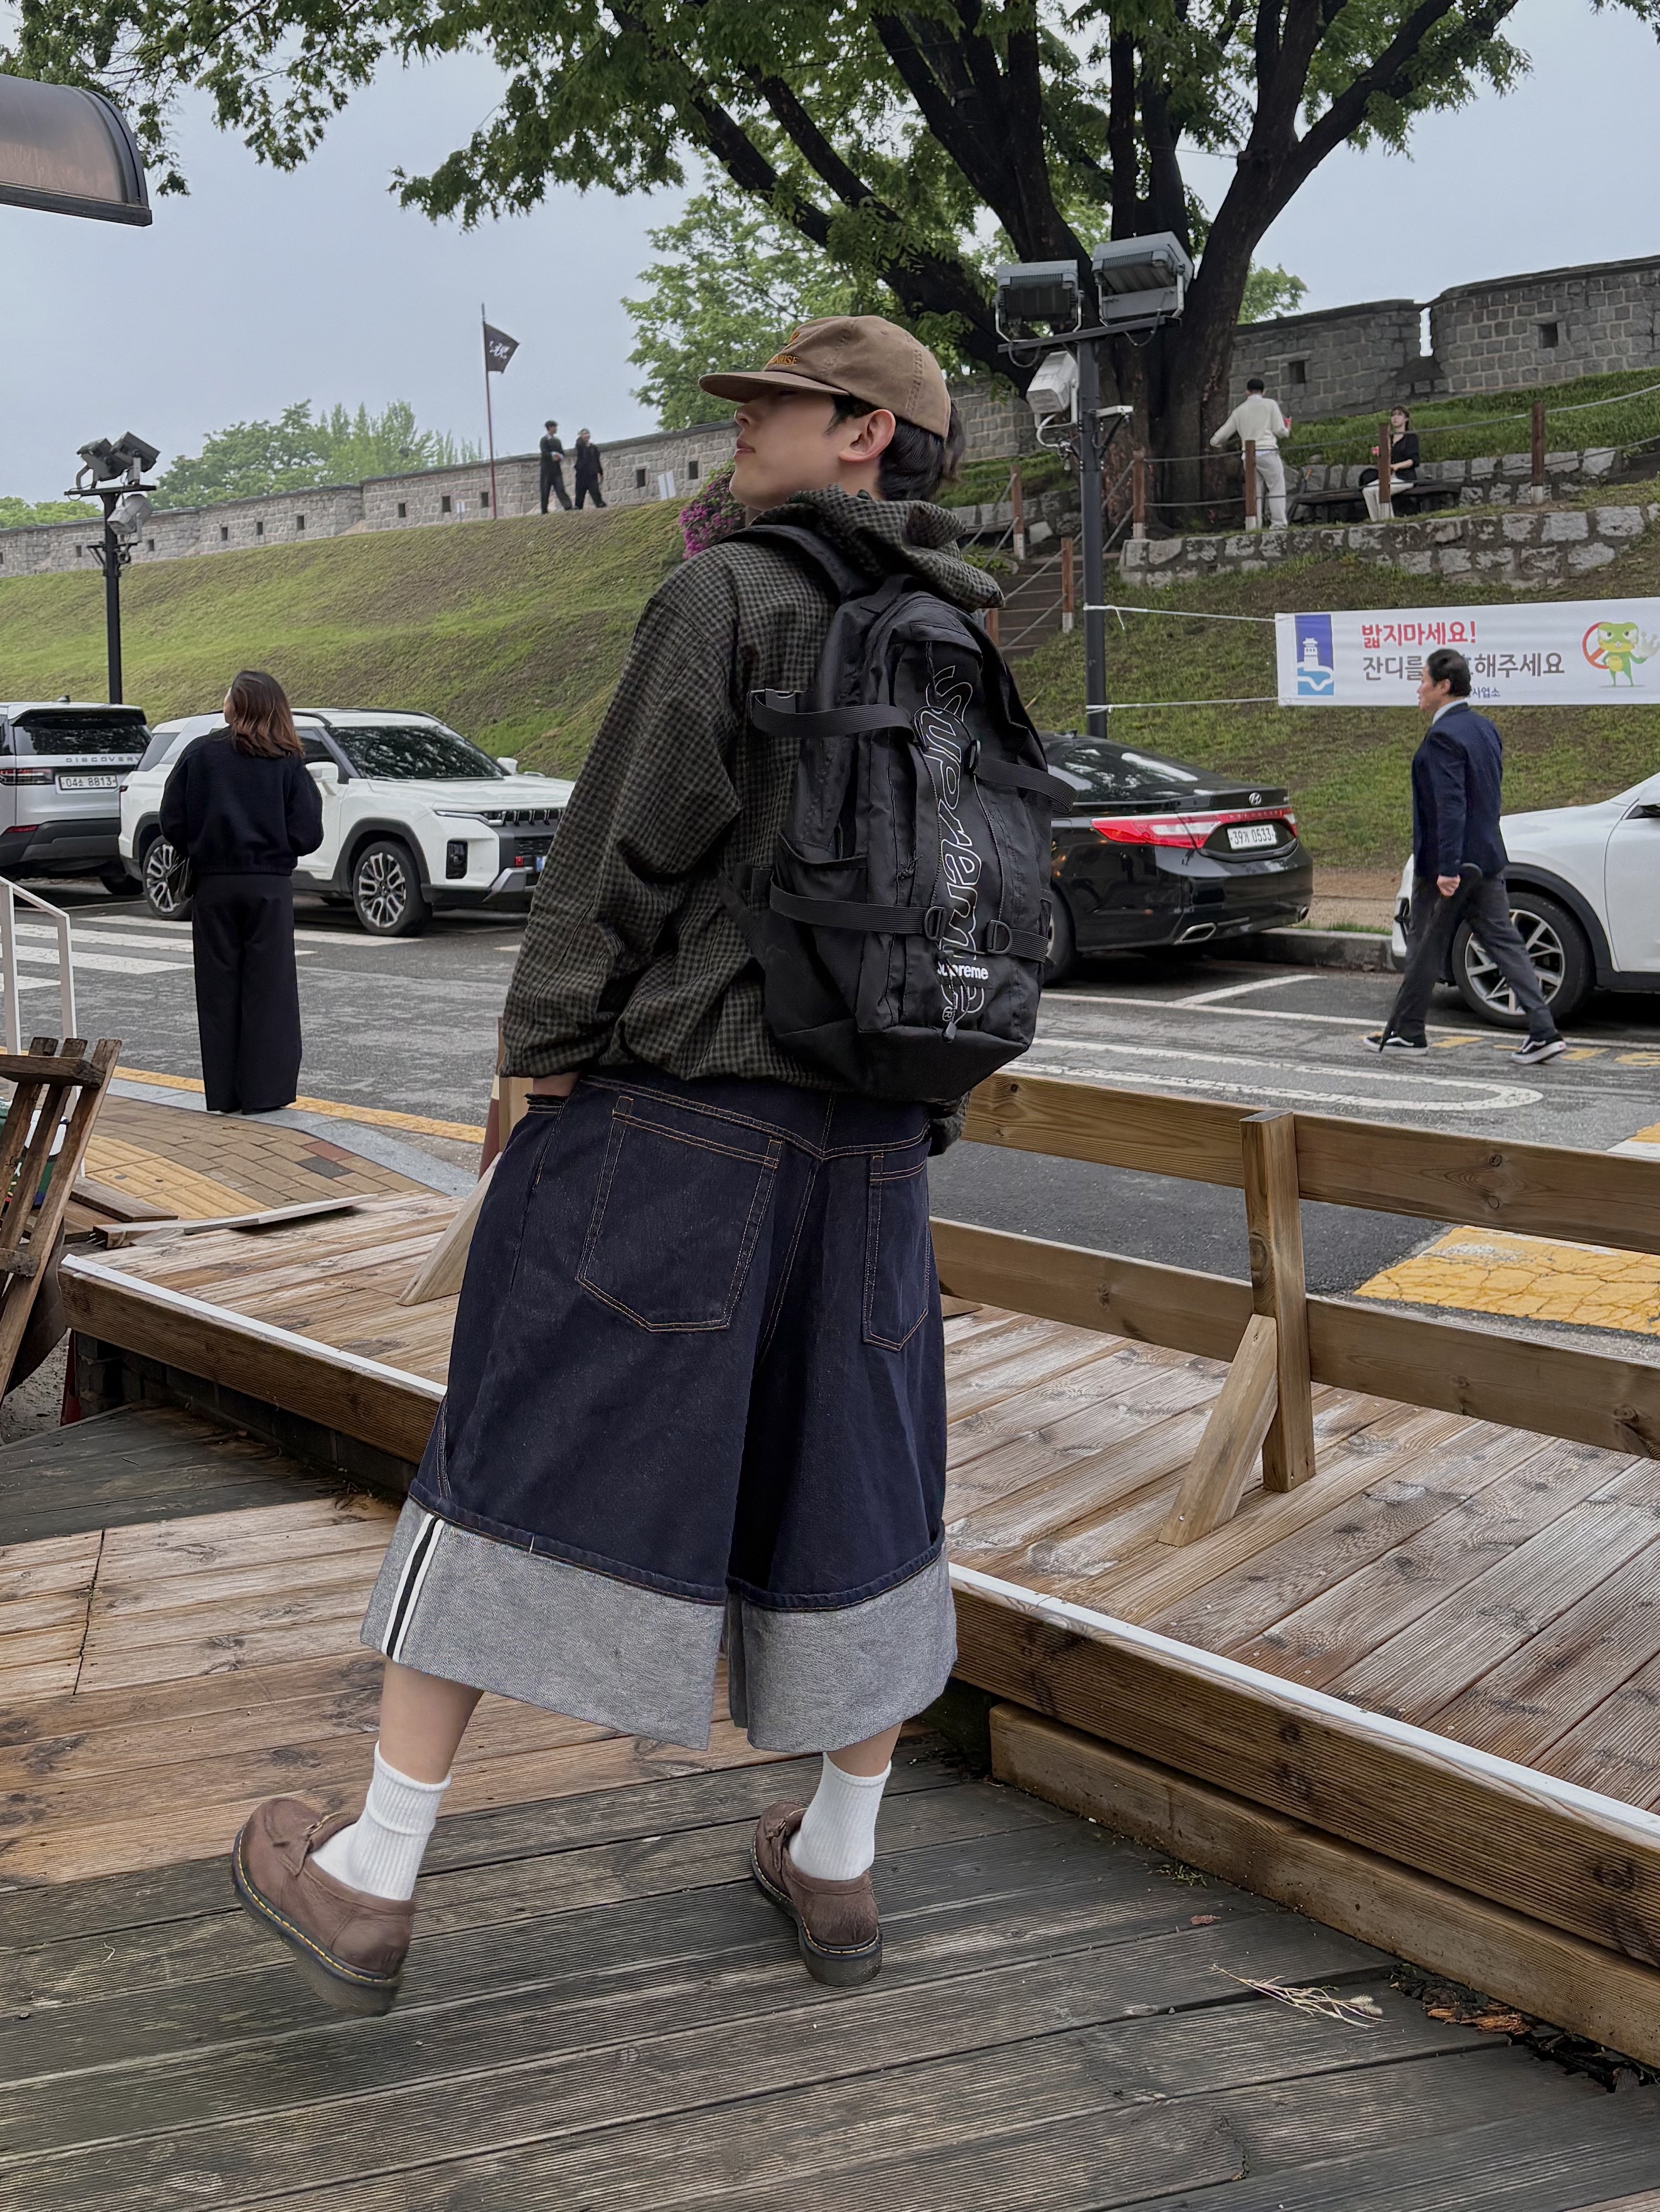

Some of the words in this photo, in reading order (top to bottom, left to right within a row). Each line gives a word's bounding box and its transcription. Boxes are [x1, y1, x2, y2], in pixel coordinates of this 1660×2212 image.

[1361, 621, 1476, 649] 밟지마세요!
[1363, 655, 1424, 681] 잔디를
[1463, 652, 1565, 678] 해주세요
[1469, 686, 1500, 699] 사업소
[88, 776, 112, 786] 8813
[1251, 827, 1272, 842] 0533
